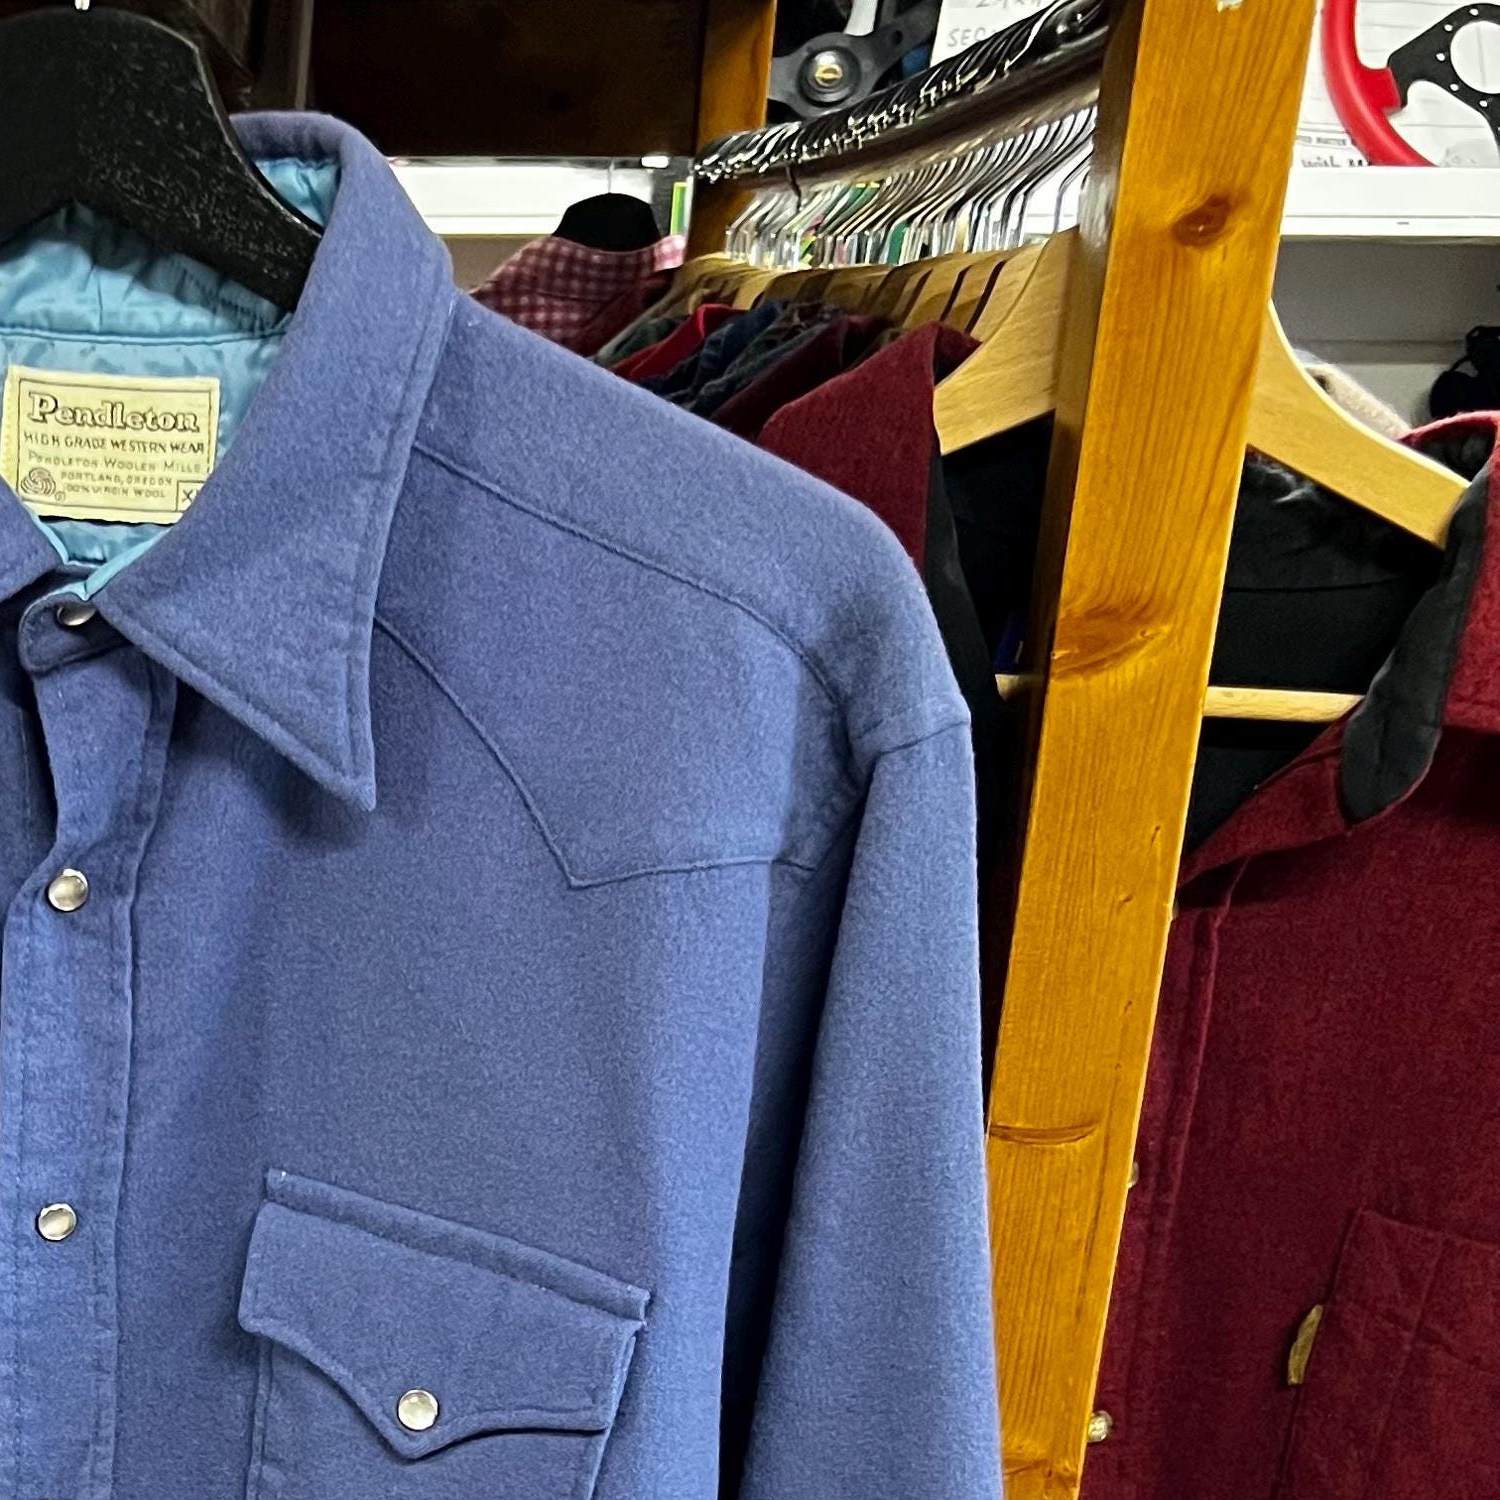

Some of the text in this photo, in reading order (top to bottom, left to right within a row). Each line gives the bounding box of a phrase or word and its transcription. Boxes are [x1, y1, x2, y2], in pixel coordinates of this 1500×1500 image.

[28, 391, 201, 433] Pendleton
[23, 431, 205, 454] HIGH GRADE WESTERN WEAR
[61, 471, 172, 486] PORTLAND, OREGON
[92, 485, 129, 497] VIRGIN
[134, 488, 166, 498] WOOL
